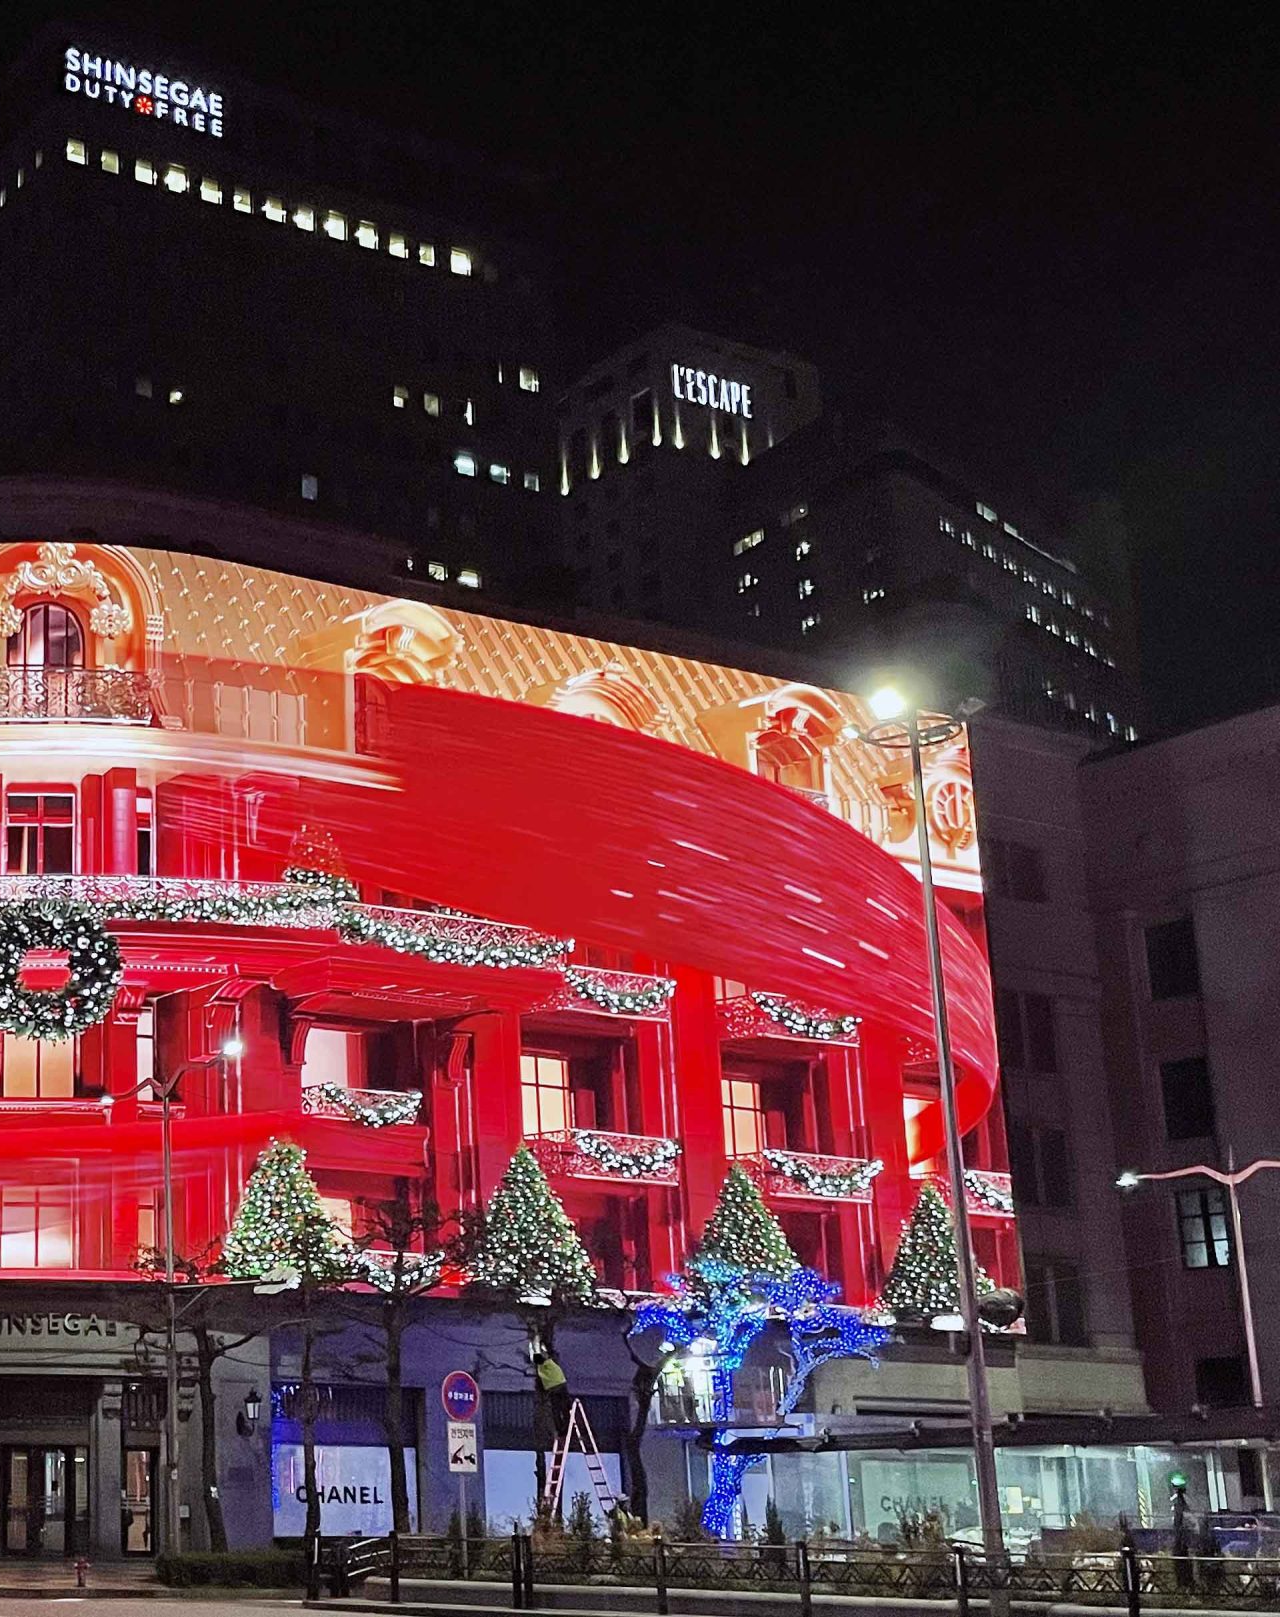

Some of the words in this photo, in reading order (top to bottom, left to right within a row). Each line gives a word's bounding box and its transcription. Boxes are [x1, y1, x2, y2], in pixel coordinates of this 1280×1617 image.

[65, 47, 223, 118] SHINSEGAE
[65, 72, 134, 108] DUTY
[155, 101, 223, 137] FREE
[672, 363, 752, 418] L'ESCAPE
[295, 1485, 384, 1504] CHANEL
